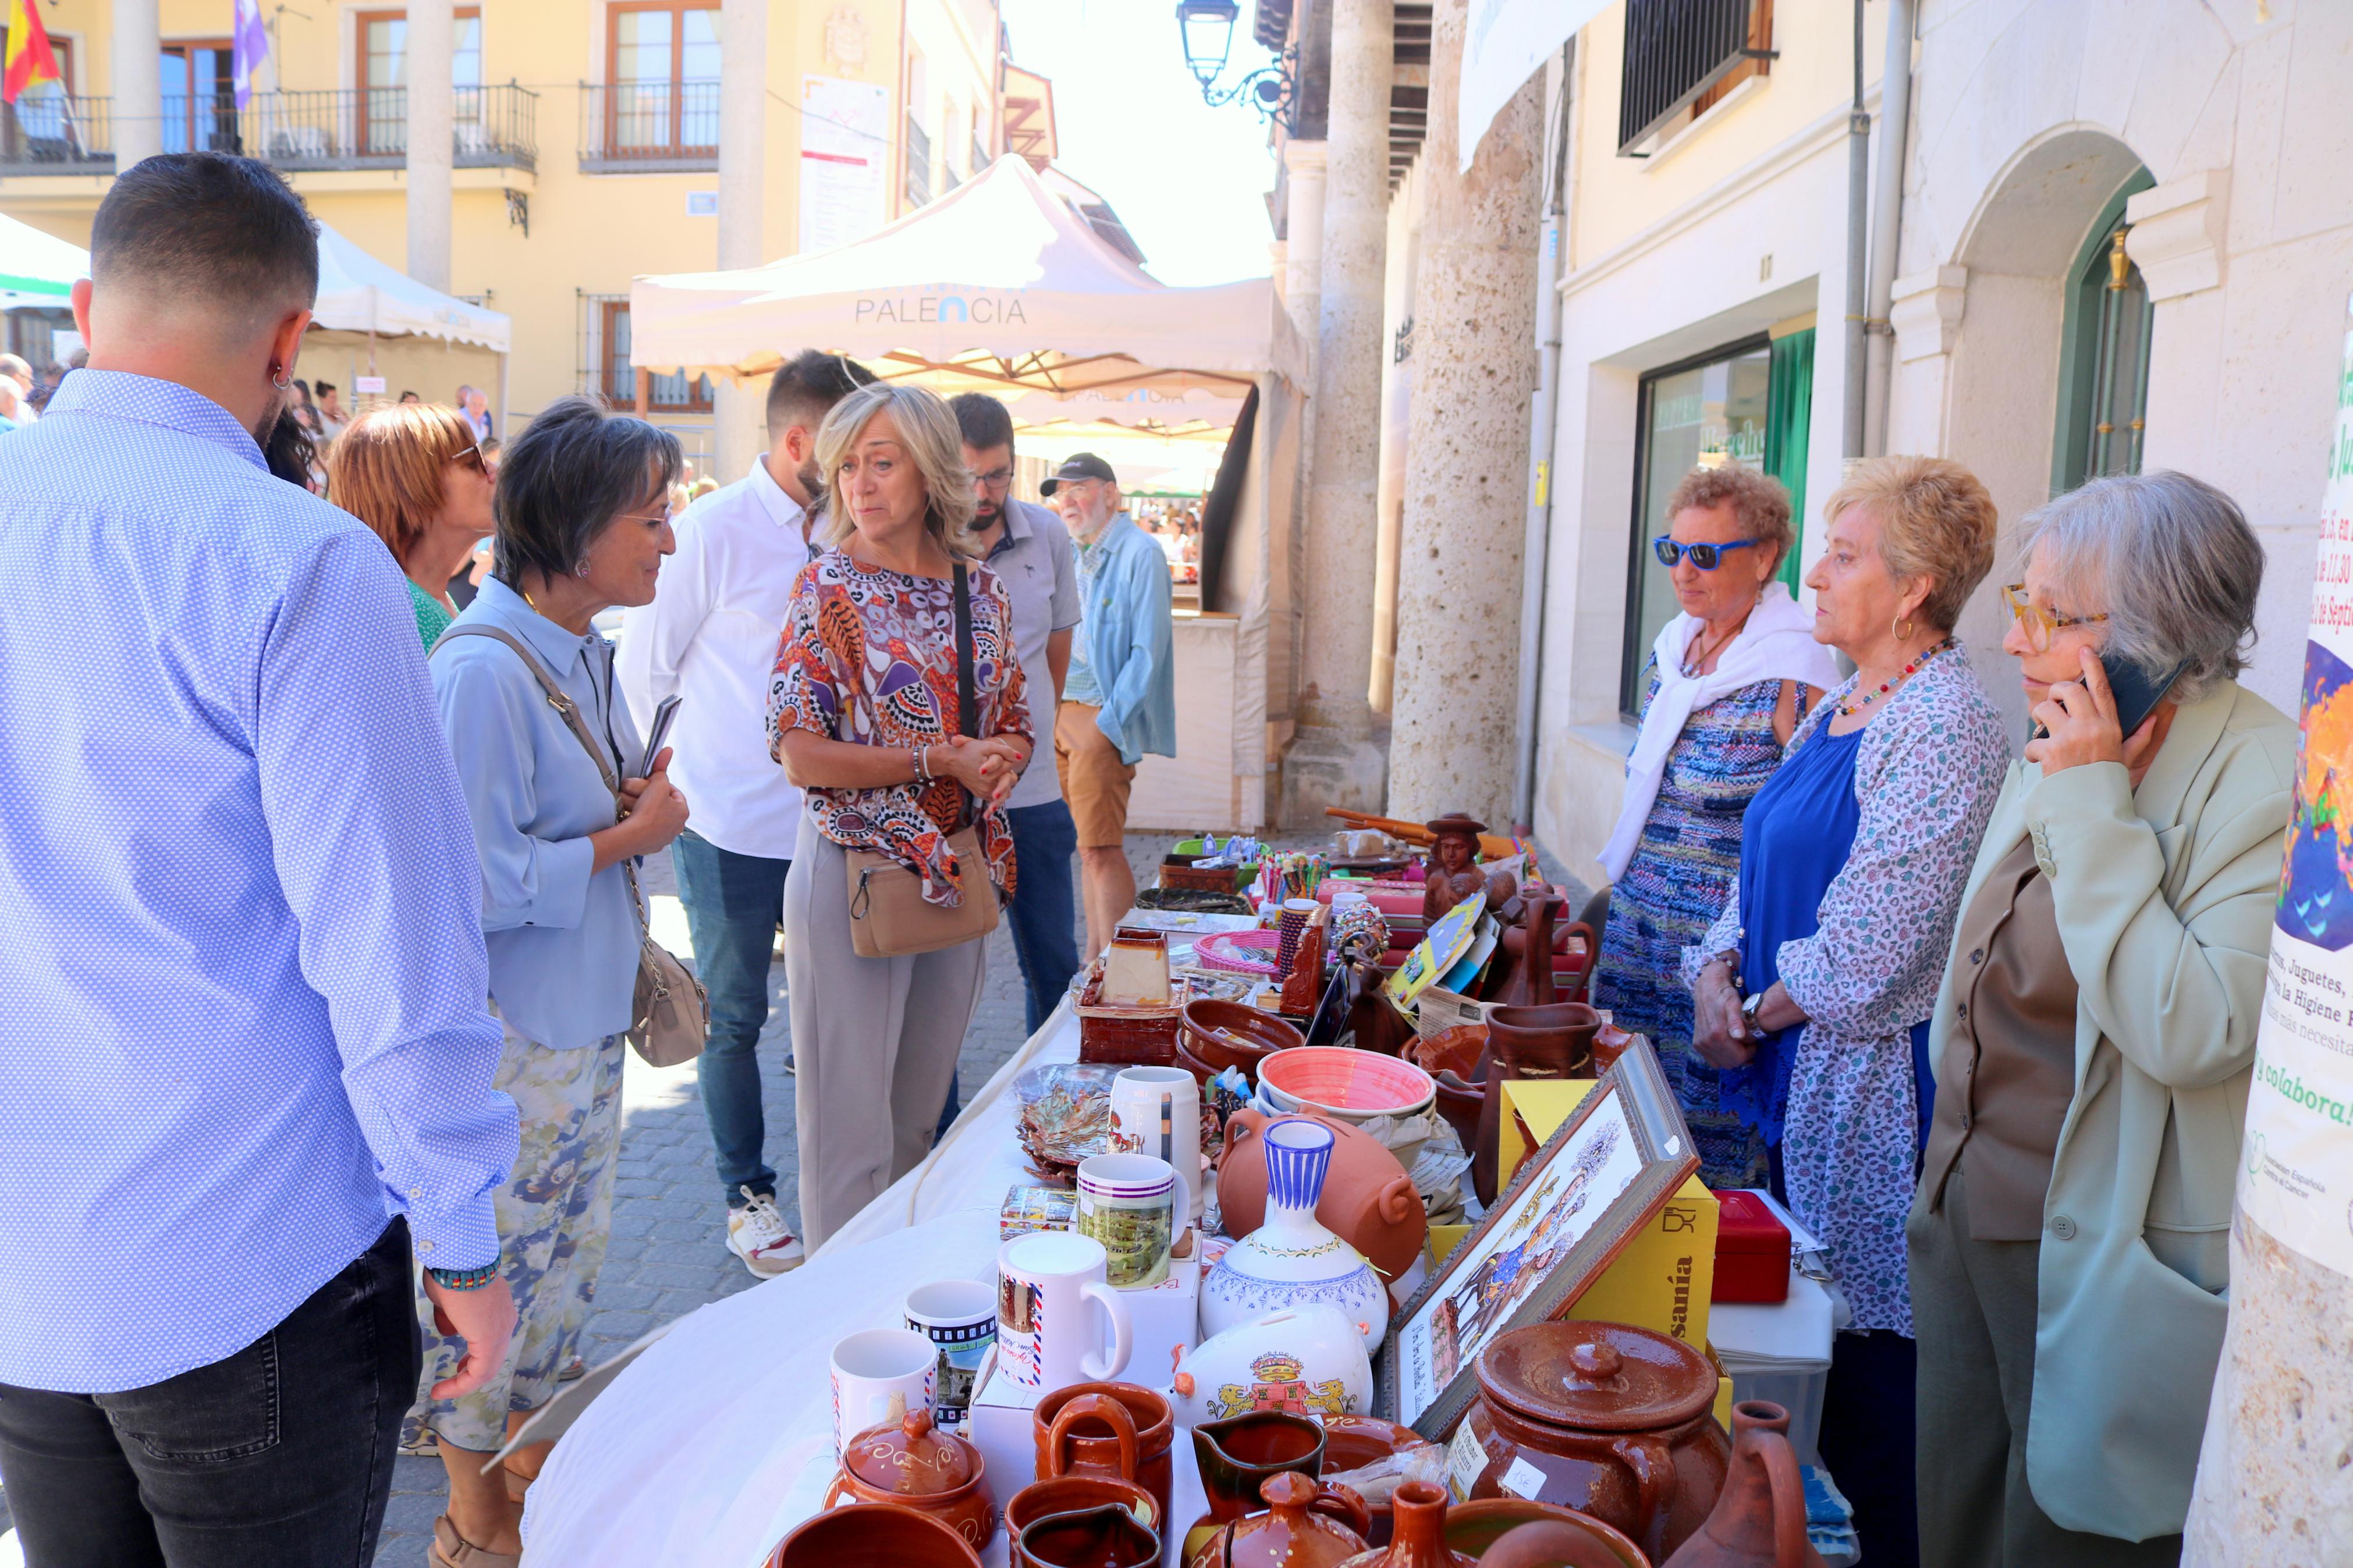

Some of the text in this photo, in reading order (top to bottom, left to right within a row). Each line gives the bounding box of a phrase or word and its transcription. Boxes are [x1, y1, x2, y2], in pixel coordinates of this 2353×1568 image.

[2288, 959, 2345, 999] Juguetes,
[2282, 983, 2291, 1001] la
[2294, 989, 2341, 1022] Higiene
[2266, 1064, 2353, 1126] colabora!
[1667, 1255, 1693, 1338] sanía
[1007, 1349, 1031, 1364] Iglesia
[1020, 1345, 1037, 1355] San
